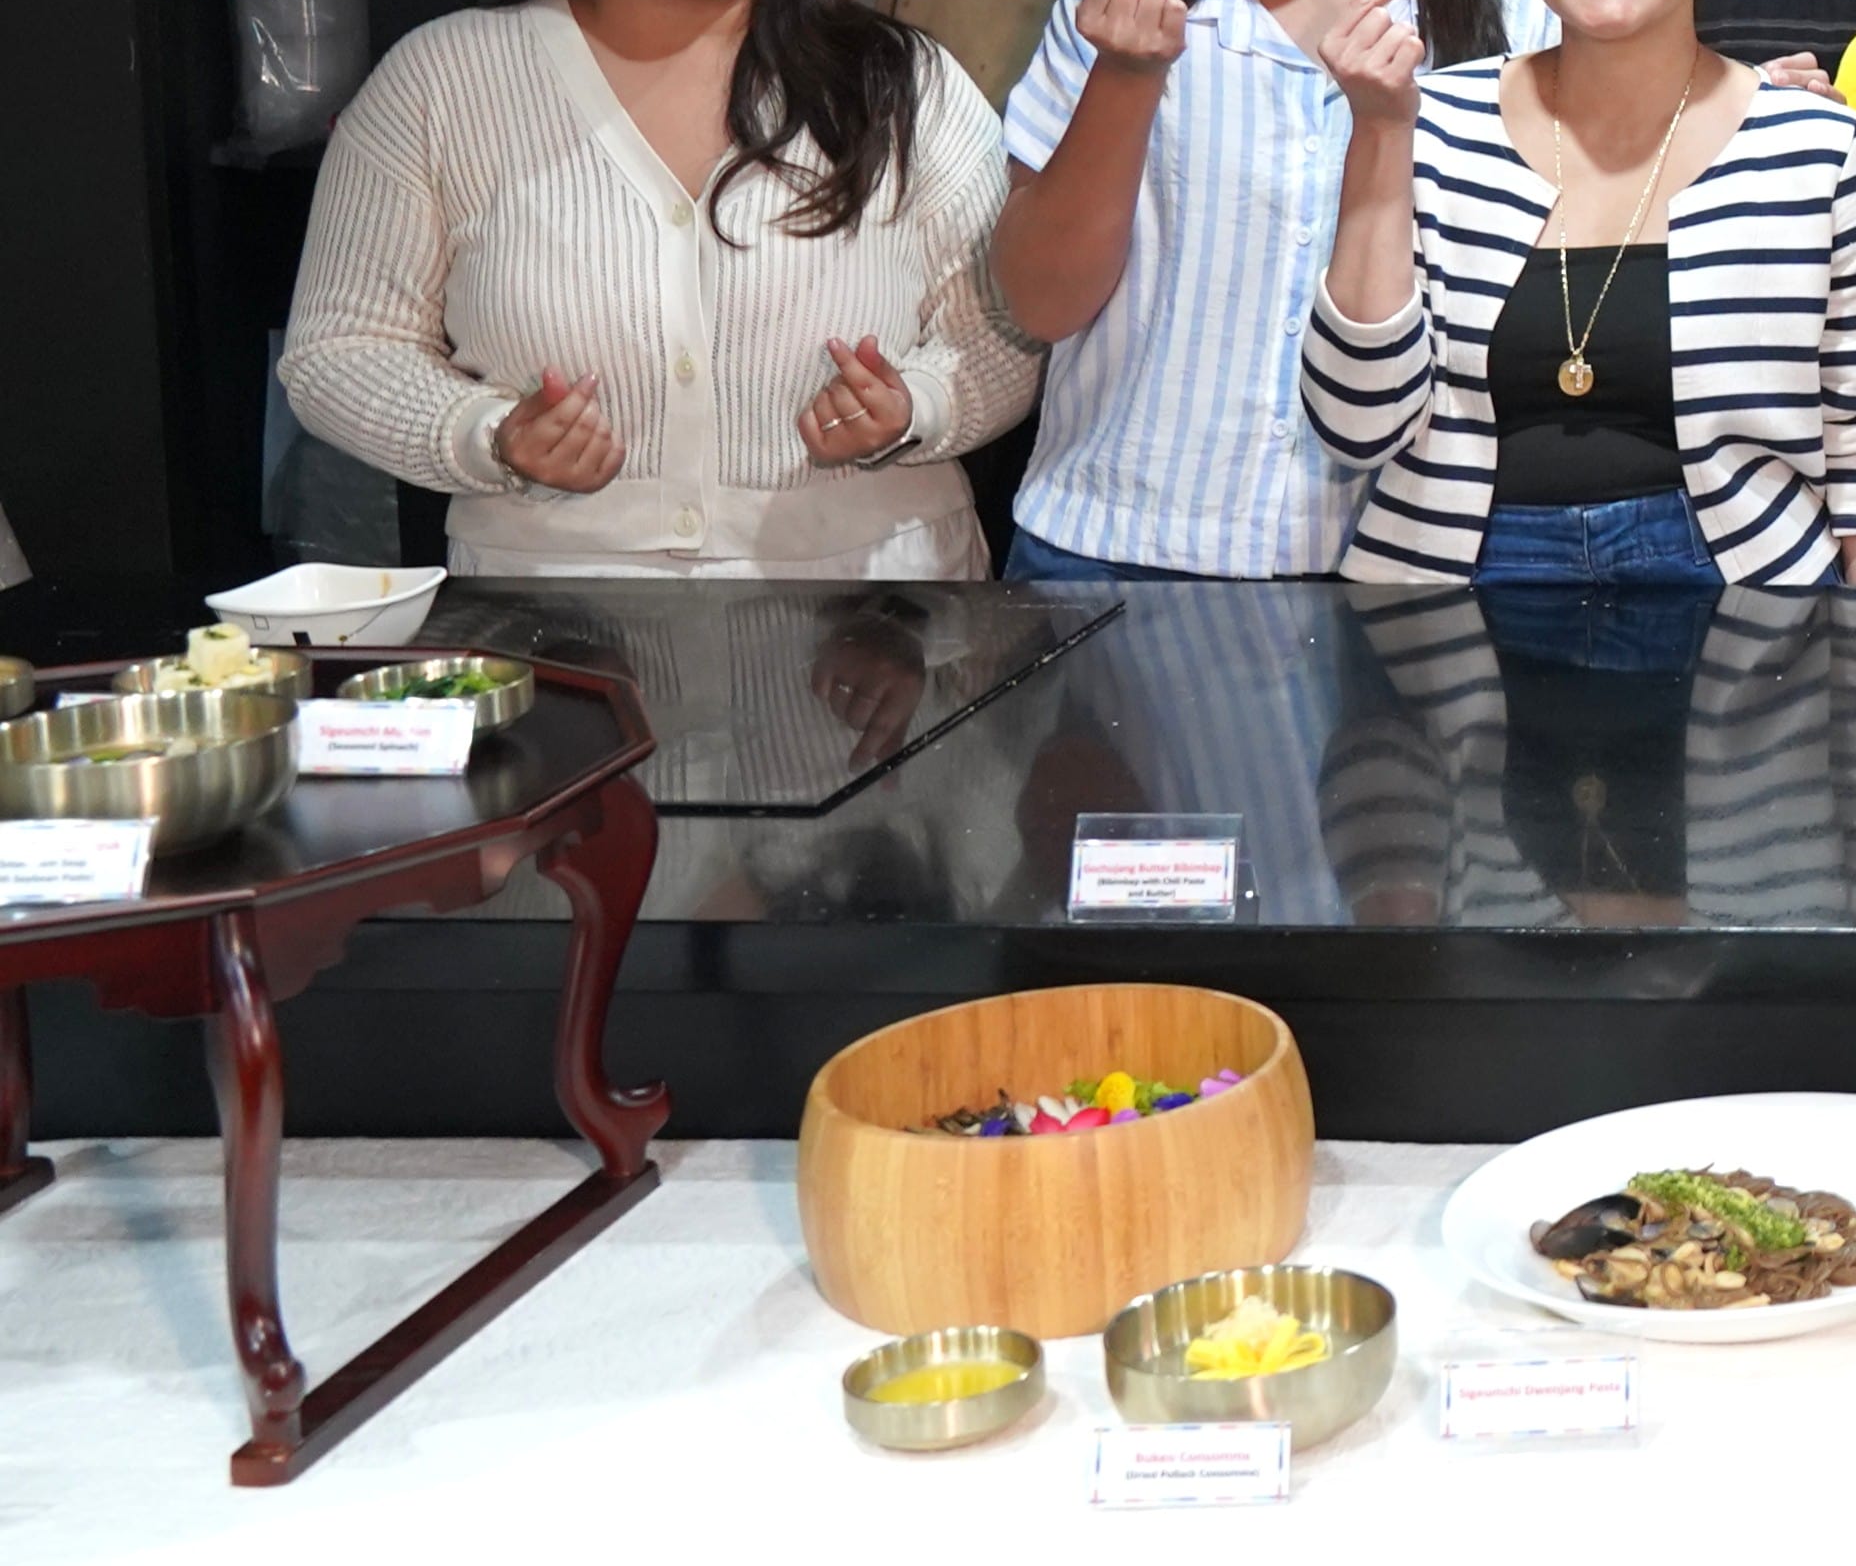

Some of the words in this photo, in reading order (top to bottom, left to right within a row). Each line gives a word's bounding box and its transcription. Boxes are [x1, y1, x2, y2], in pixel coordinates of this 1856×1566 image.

[1139, 863, 1171, 873] Butter
[1174, 863, 1222, 874] Bibimbap
[1142, 877, 1161, 885] with
[1128, 890, 1144, 898] and
